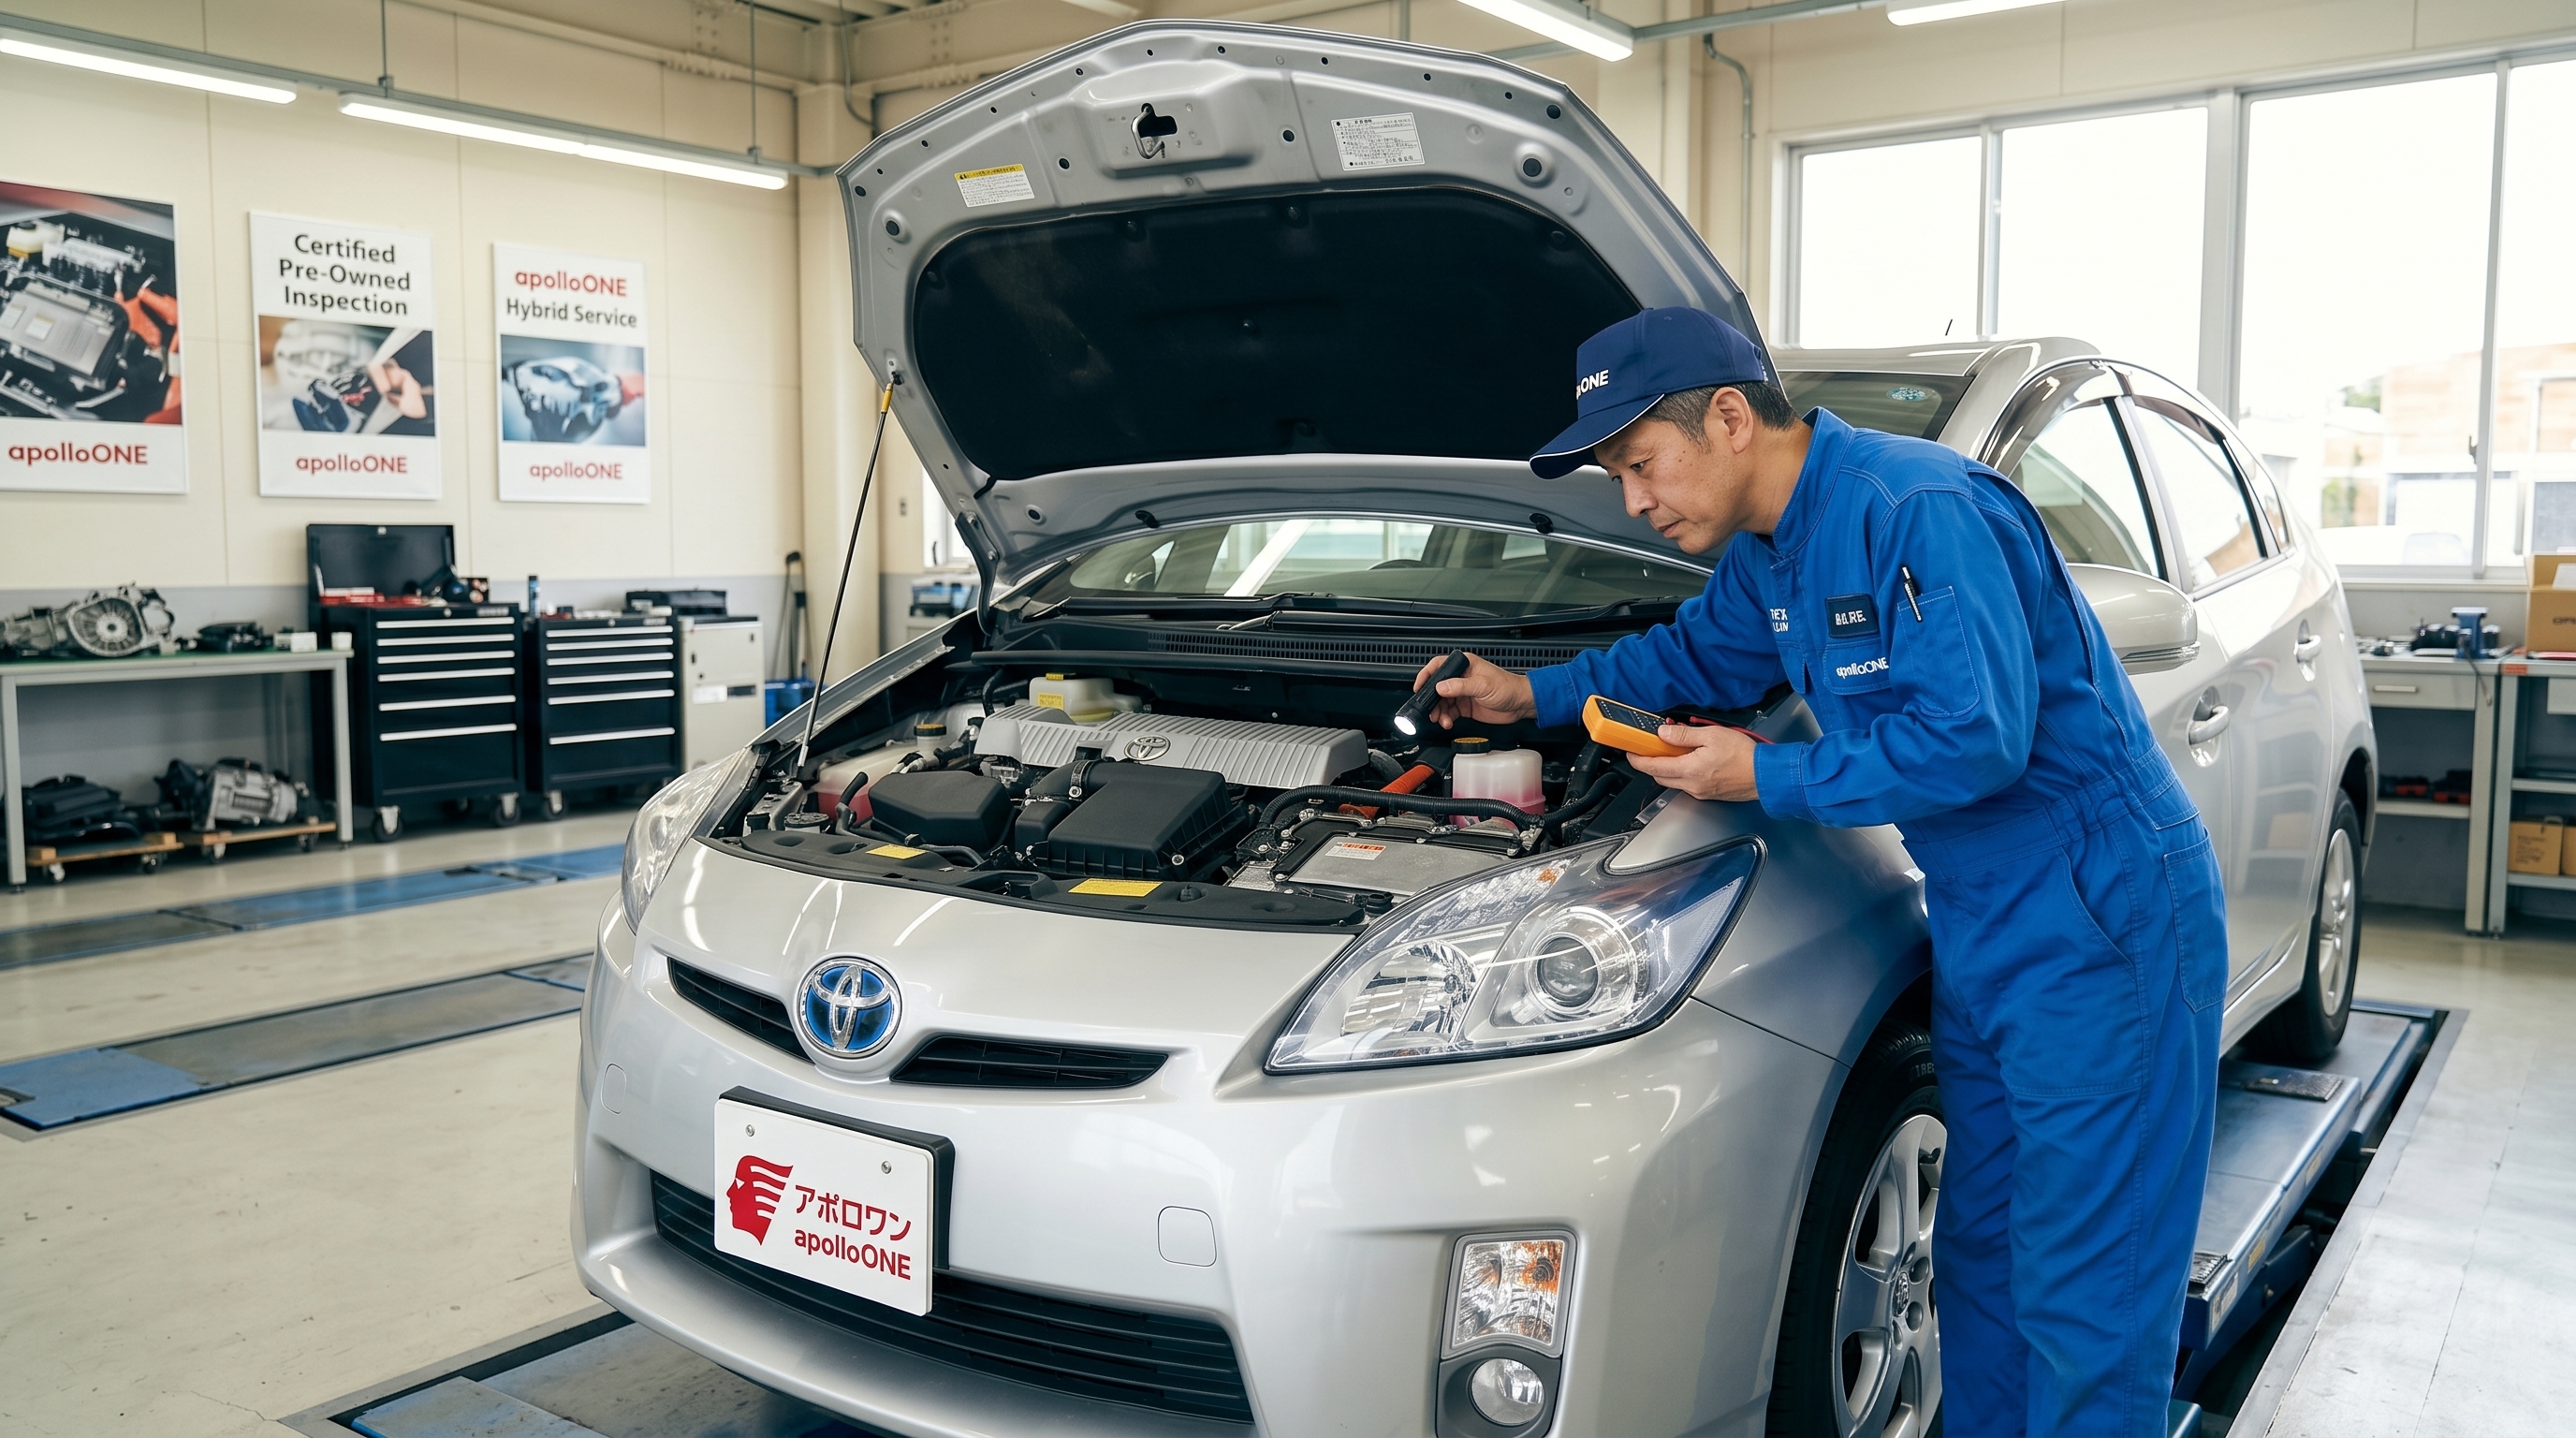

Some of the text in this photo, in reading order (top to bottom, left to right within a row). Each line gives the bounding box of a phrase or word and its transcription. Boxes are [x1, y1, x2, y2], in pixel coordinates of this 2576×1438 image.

[294, 233, 395, 264] Certified
[279, 257, 410, 291] Pre-Owned
[515, 271, 626, 297] apolloONE
[285, 285, 408, 315] Inspection
[506, 298, 637, 328] Hybrid Service
[8, 442, 148, 466] apolloONE
[296, 454, 407, 476] apolloONE
[530, 462, 623, 482] apolloONE
[795, 1184, 912, 1241] アポロワン
[794, 1229, 911, 1281] apolloONE
